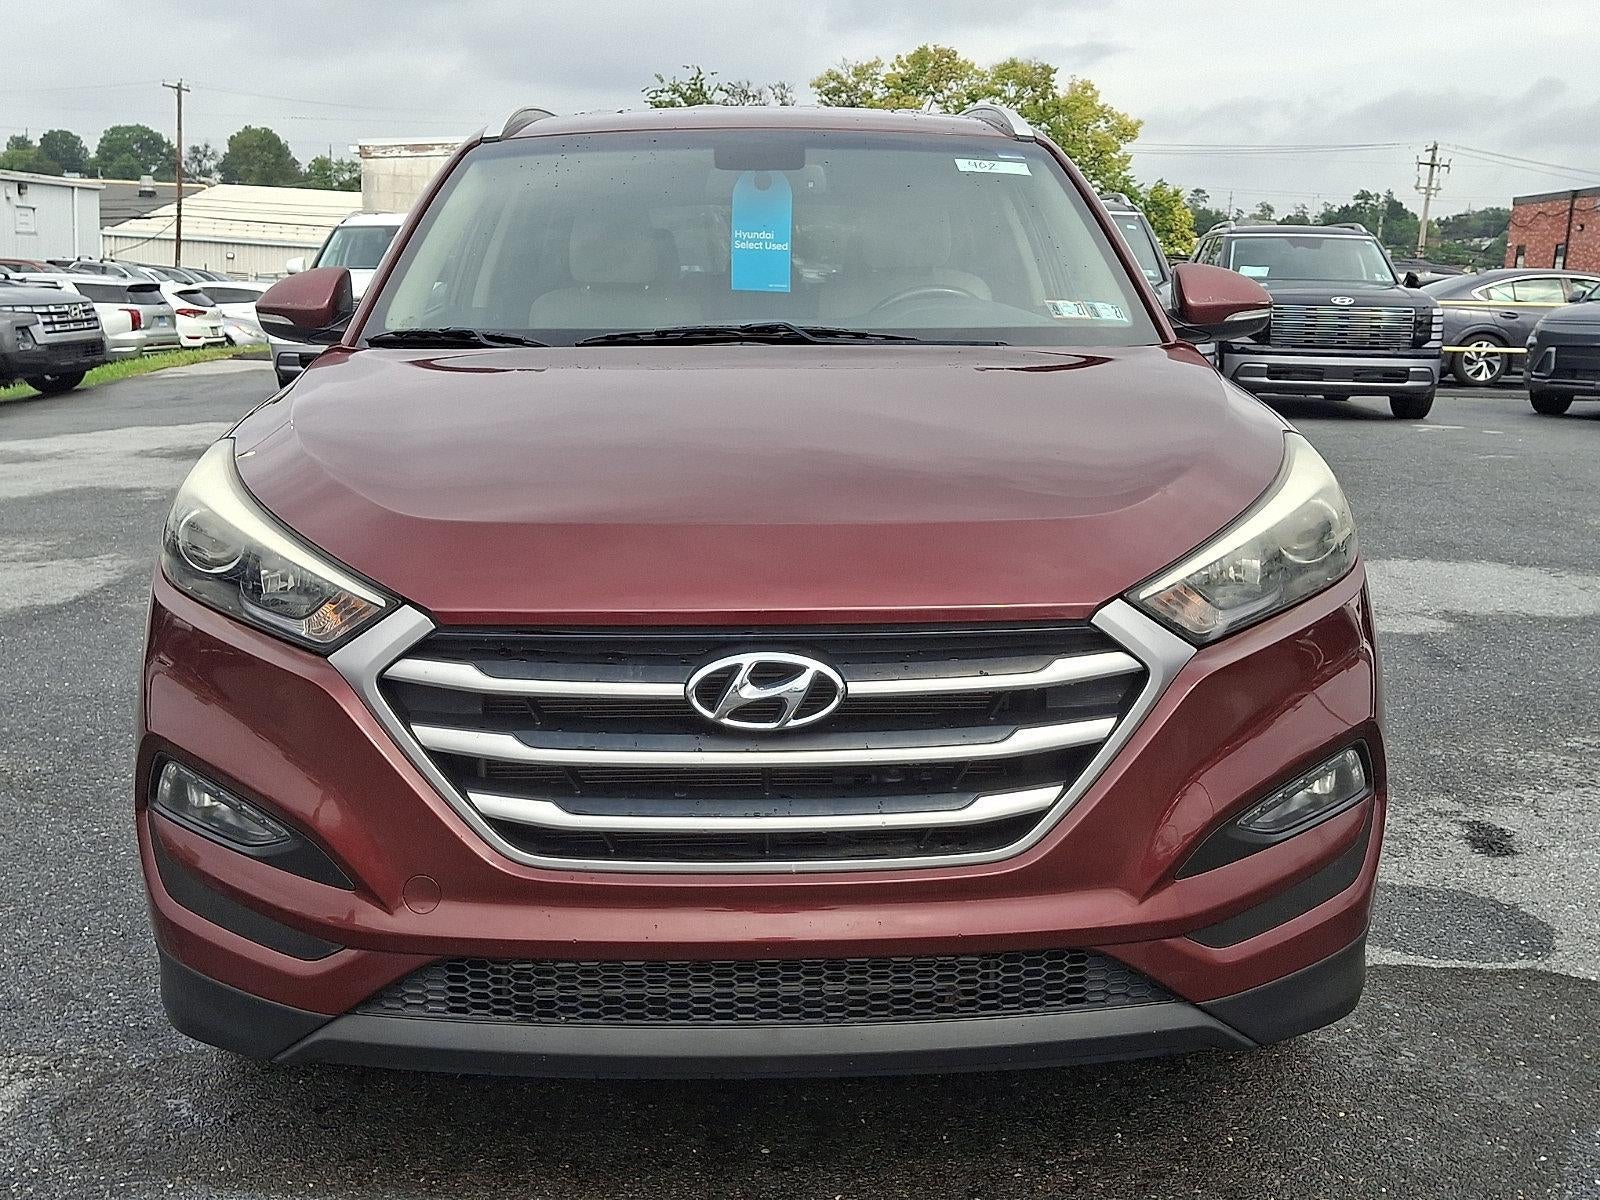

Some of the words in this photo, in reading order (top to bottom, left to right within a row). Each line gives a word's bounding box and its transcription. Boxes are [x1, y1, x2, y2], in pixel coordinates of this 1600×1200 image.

[734, 230, 774, 240] Hyundai
[734, 240, 763, 249] Select
[765, 242, 788, 250] Used
